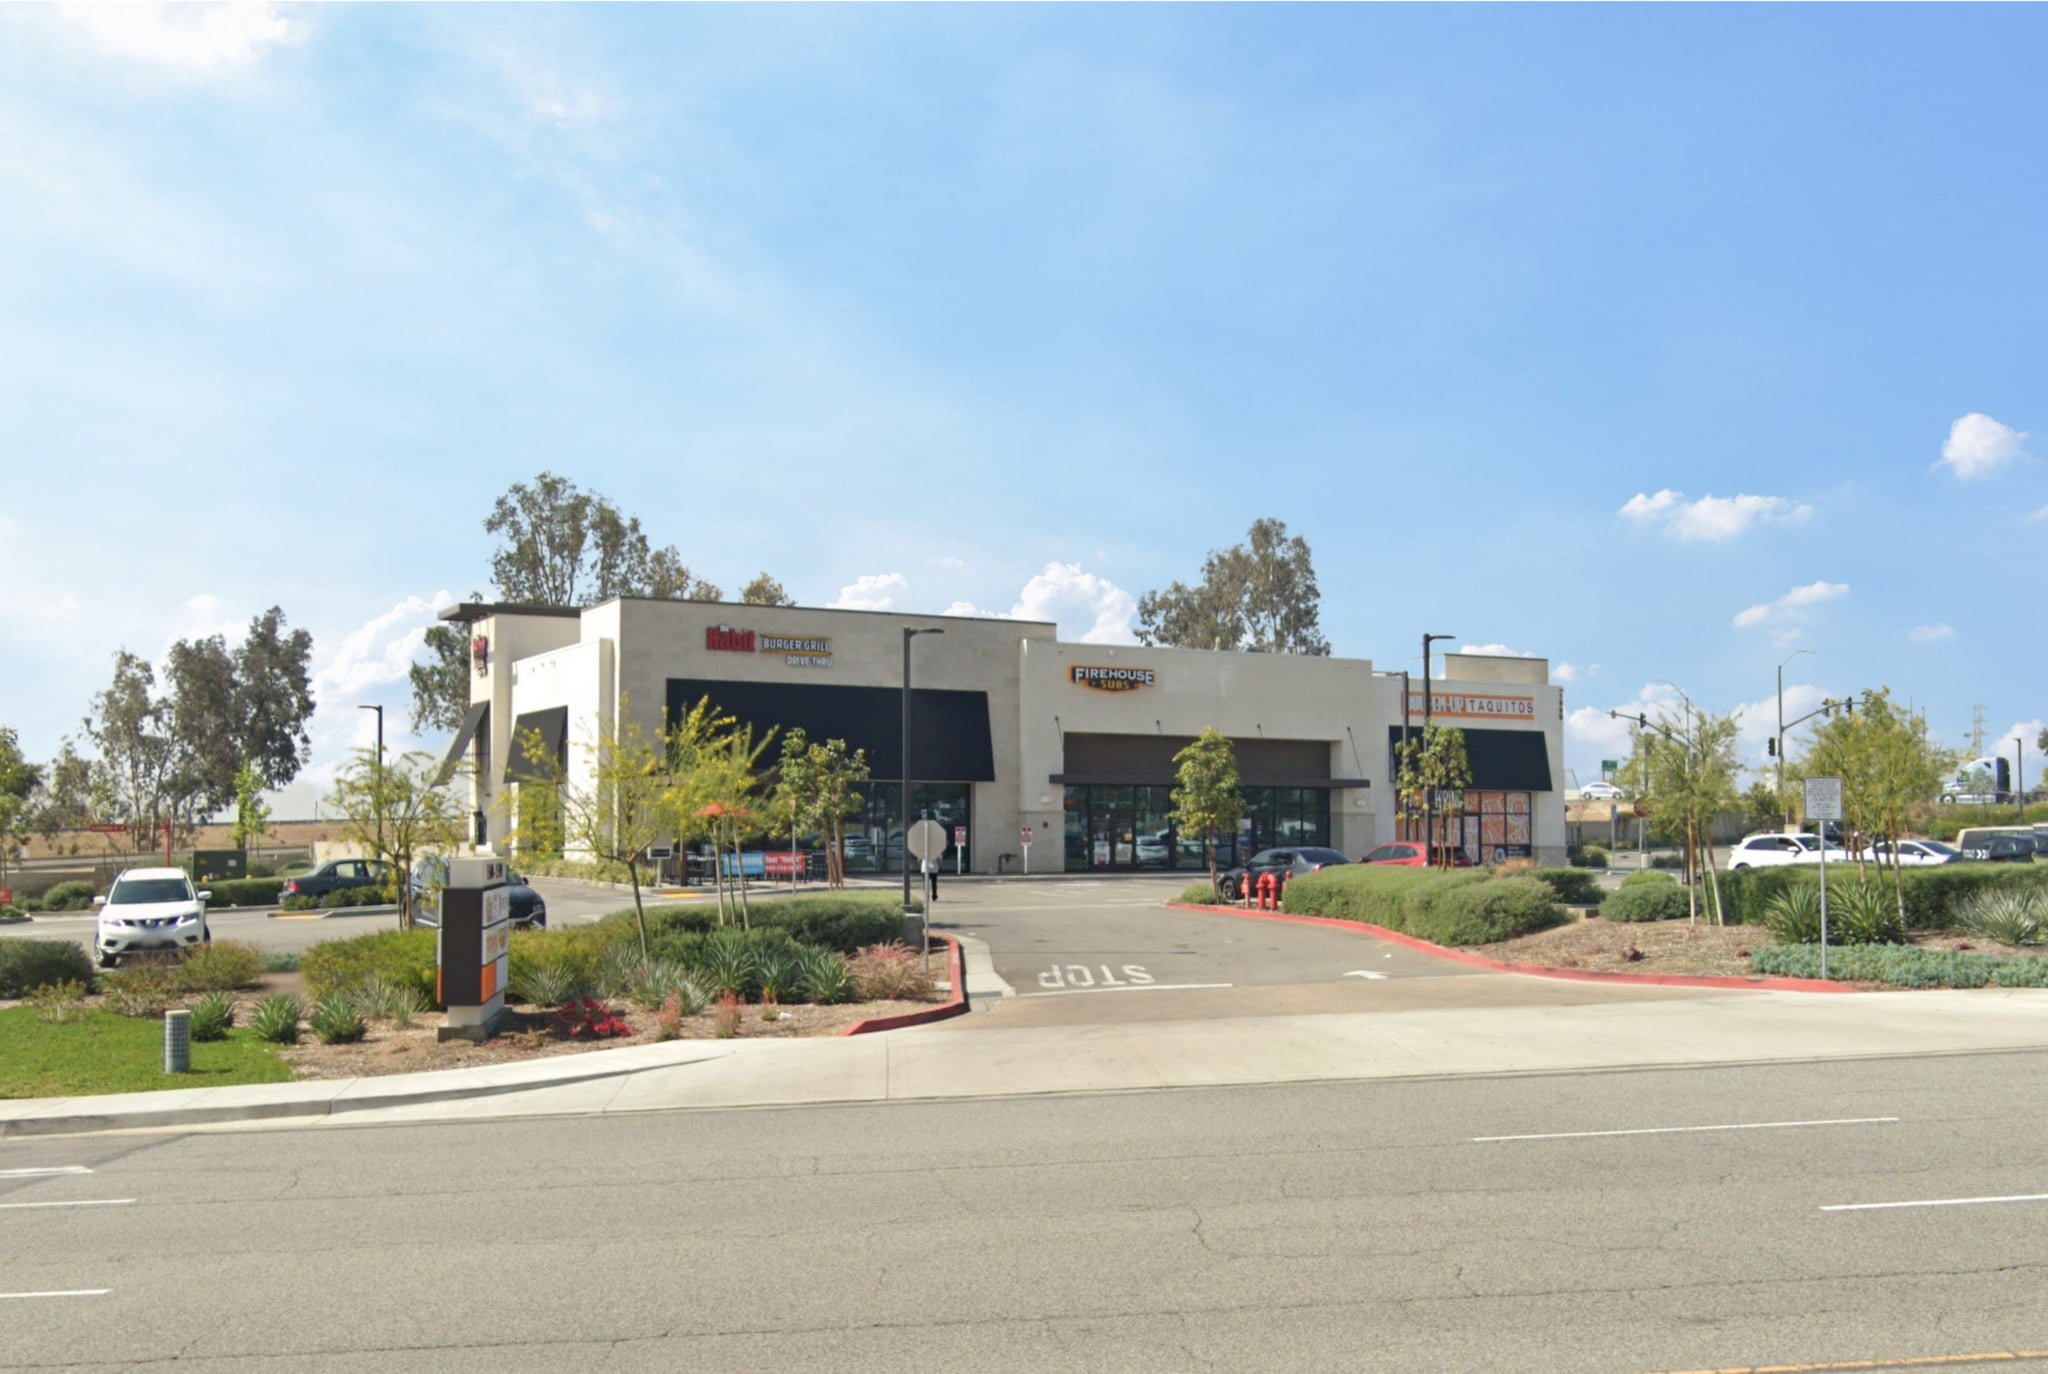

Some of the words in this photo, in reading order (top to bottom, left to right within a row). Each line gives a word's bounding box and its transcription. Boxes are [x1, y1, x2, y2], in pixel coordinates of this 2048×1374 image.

[706, 625, 756, 653] Habit
[763, 639, 801, 650] BURGER
[803, 641, 830, 651] GRILL
[786, 656, 810, 665] DRIVE
[812, 657, 832, 667] THRU
[1075, 667, 1154, 687] FIREHOUSE
[1101, 679, 1129, 689] SUBS
[1405, 696, 1464, 713] OL-EM-UP
[1470, 699, 1534, 714] TAQUITOS
[1038, 964, 1155, 988] STOP
